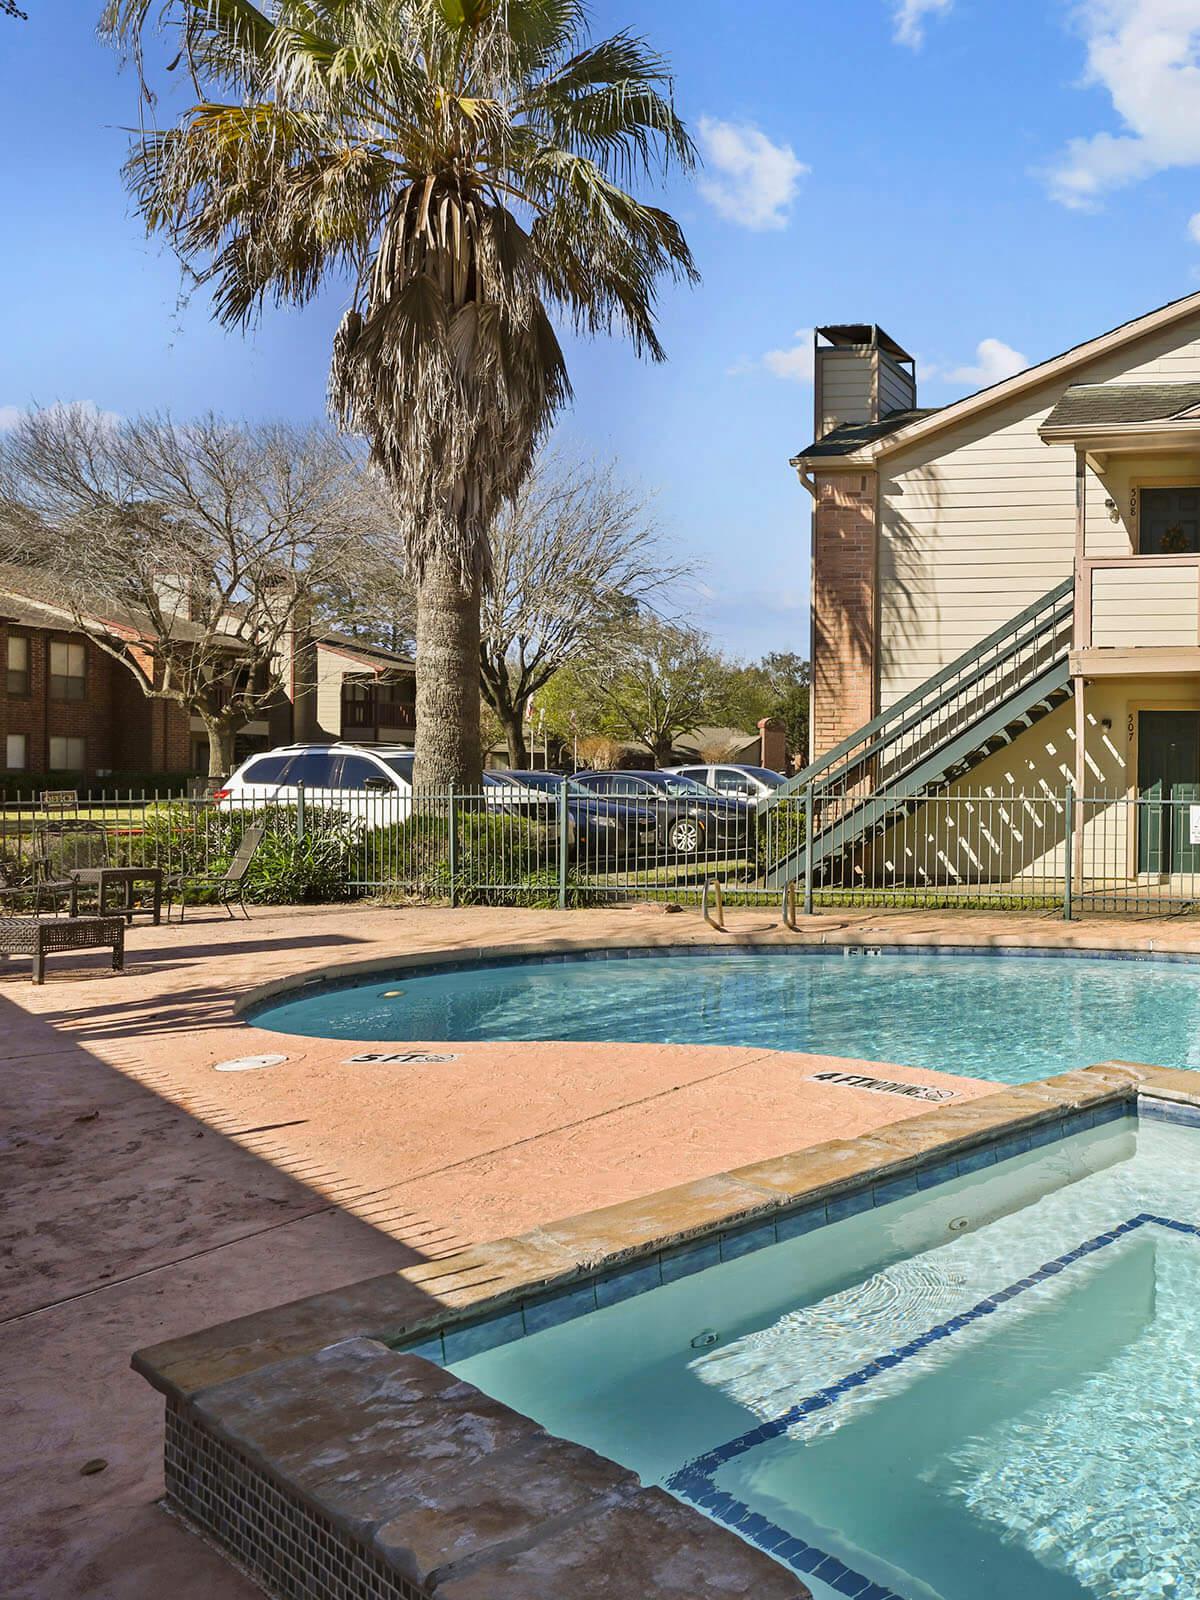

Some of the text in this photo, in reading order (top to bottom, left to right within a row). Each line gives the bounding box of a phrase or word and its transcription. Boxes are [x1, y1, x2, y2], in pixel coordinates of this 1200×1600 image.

[351, 1054, 428, 1062] 5 FT
[814, 1072, 843, 1081] 4
[832, 1075, 874, 1086] FT
